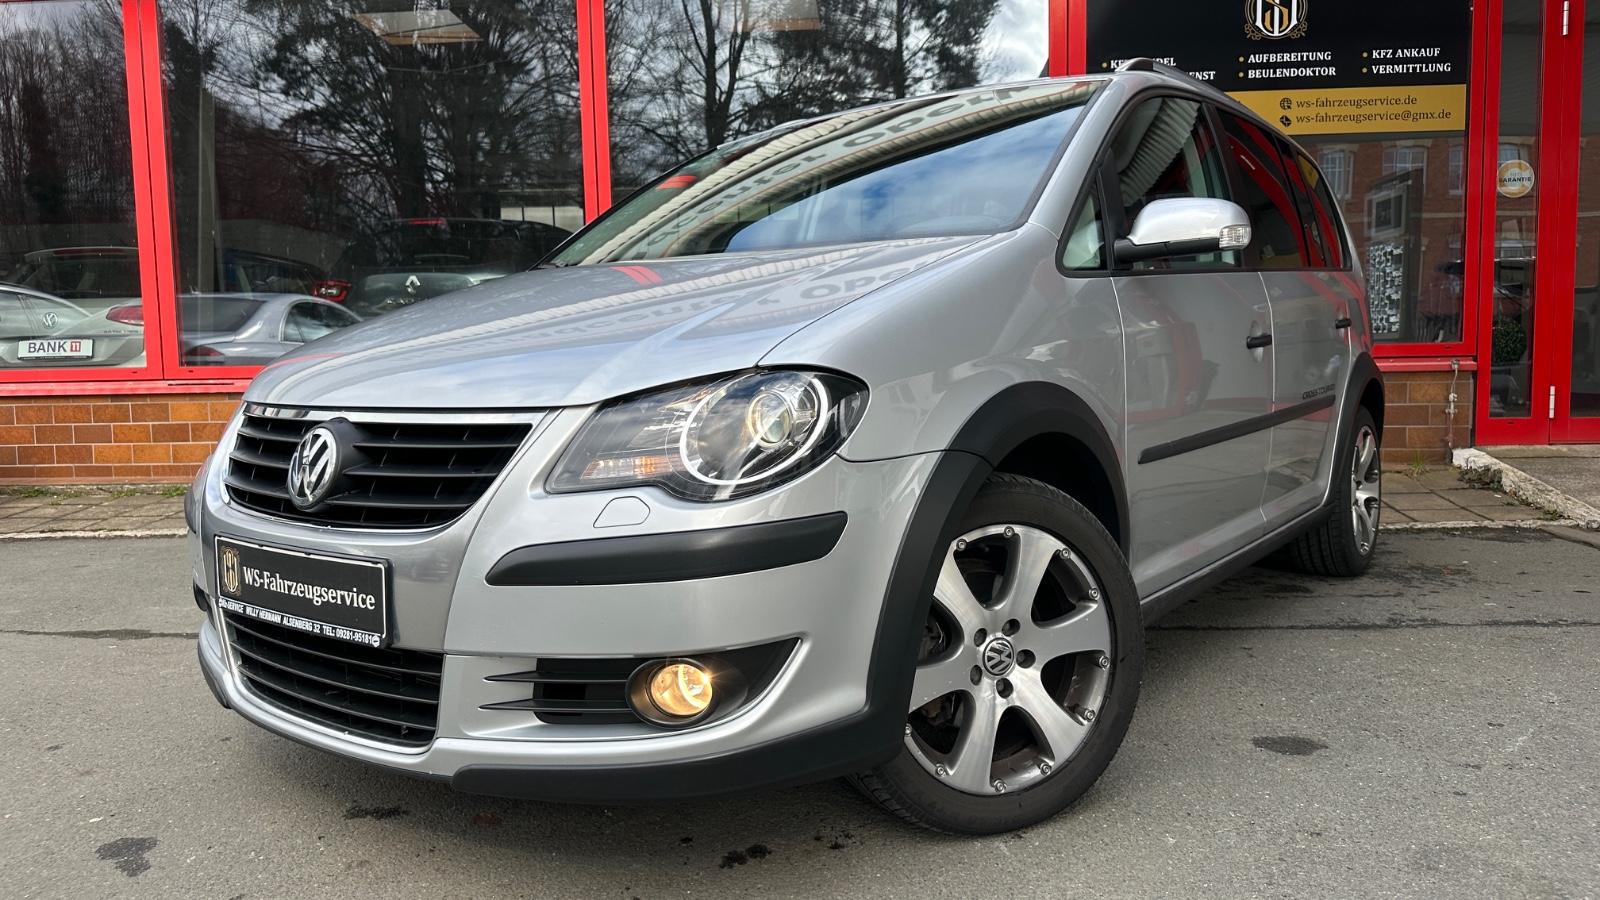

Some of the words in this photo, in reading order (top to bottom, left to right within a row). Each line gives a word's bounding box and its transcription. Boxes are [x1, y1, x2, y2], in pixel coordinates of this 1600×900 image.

[1247, 51, 1333, 64] AUFBEREITUNG
[1371, 49, 1393, 59] KFZ
[1395, 47, 1441, 58] ANKAUF
[1247, 66, 1337, 79] BEULENDOKTOR
[1371, 62, 1452, 75] VERMITTLUNG
[1296, 94, 1418, 109] ws-fahrzeugservice.de
[1296, 109, 1452, 124] ws-fahrzeugservice@gmx.de
[28, 341, 67, 354] BANK
[70, 341, 82, 353] 11
[242, 566, 376, 610] WS-Fahrzeugservice
[312, 623, 321, 634] 32
[322, 625, 335, 637] TEL:
[335, 628, 372, 644] 09281-95181
